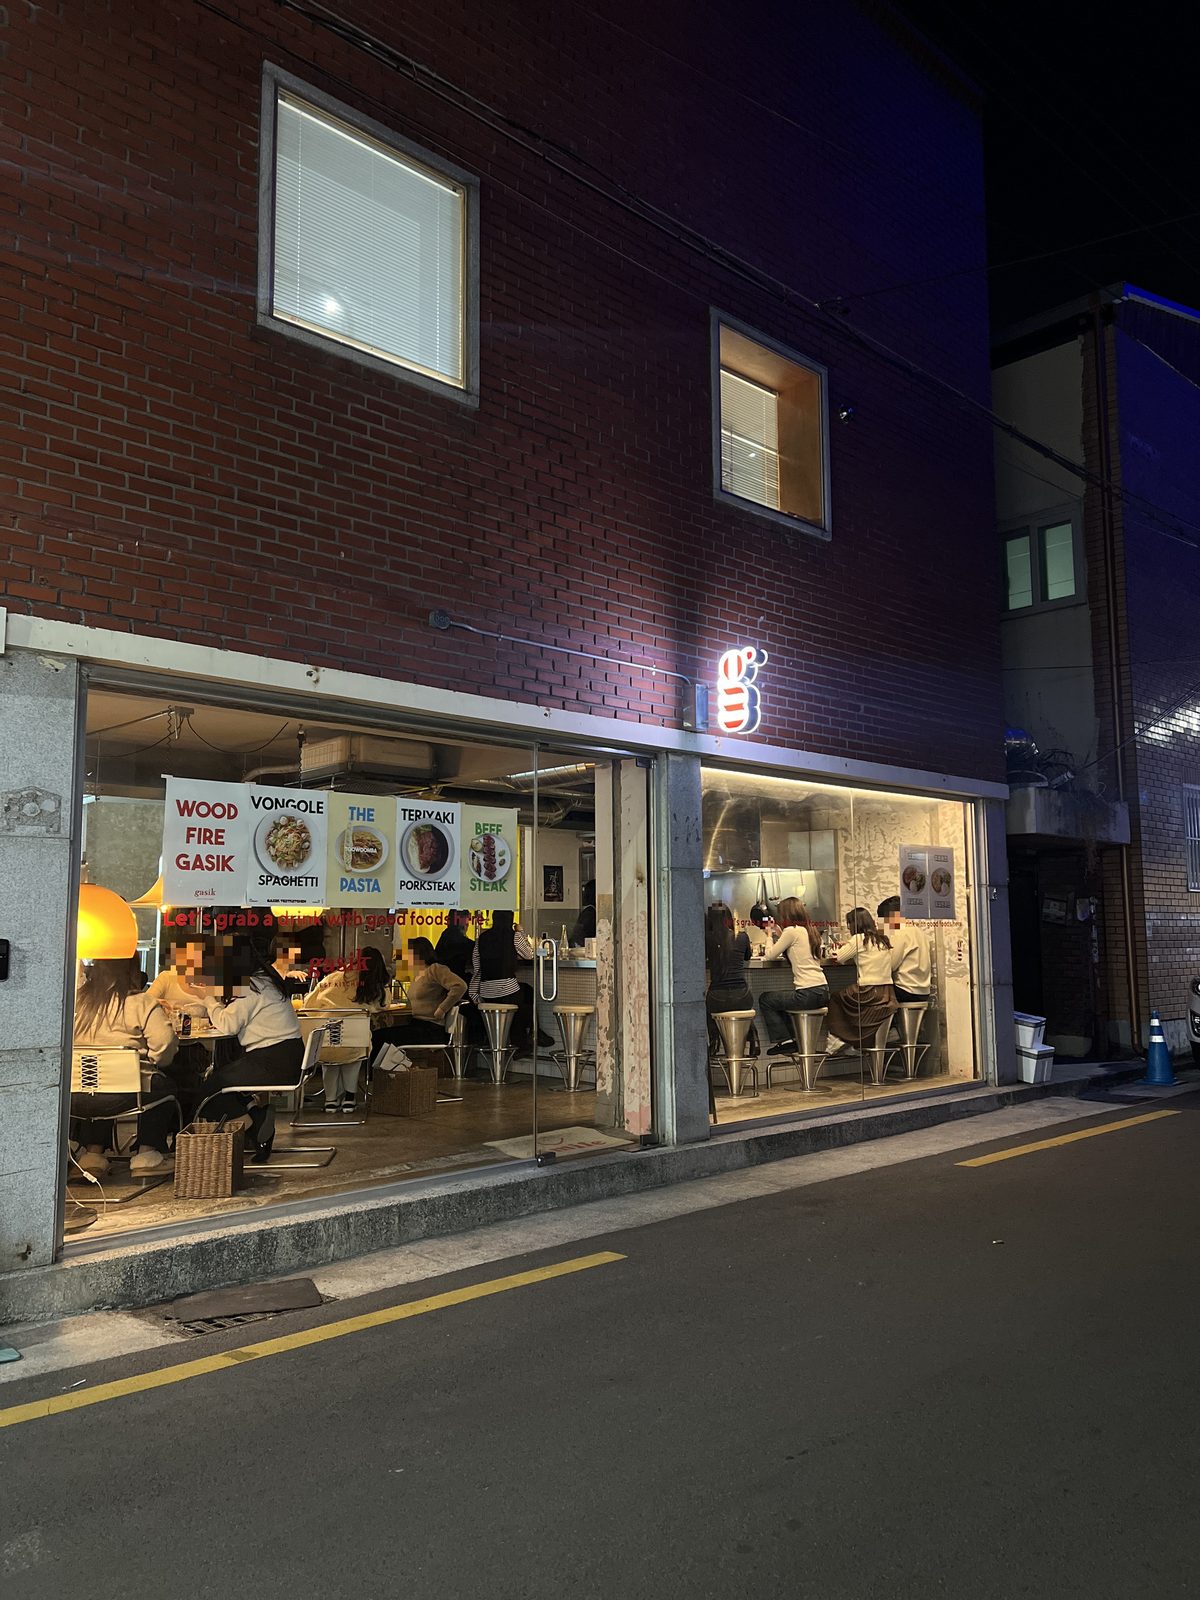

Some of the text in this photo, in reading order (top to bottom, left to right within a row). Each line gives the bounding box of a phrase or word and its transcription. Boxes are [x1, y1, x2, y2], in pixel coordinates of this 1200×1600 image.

[175, 799, 239, 820] WOOD
[250, 795, 324, 815] VONGOLE
[349, 806, 375, 822] THE
[401, 808, 455, 825] TERIYAKI
[185, 827, 226, 846] FIRE
[474, 822, 503, 836] BEEF
[175, 853, 235, 872] GASIK
[258, 874, 319, 888] SPAGHETTI
[340, 877, 381, 893] PASTA
[399, 880, 456, 892] PORKSTEAK
[469, 878, 508, 893] STEAK
[194, 887, 216, 898] gasik
[163, 909, 211, 927] Let's
[215, 911, 259, 931] grab
[263, 913, 273, 927] a
[277, 911, 323, 927] drink
[326, 911, 363, 927] with
[367, 912, 406, 931] good
[408, 911, 449, 926] foods
